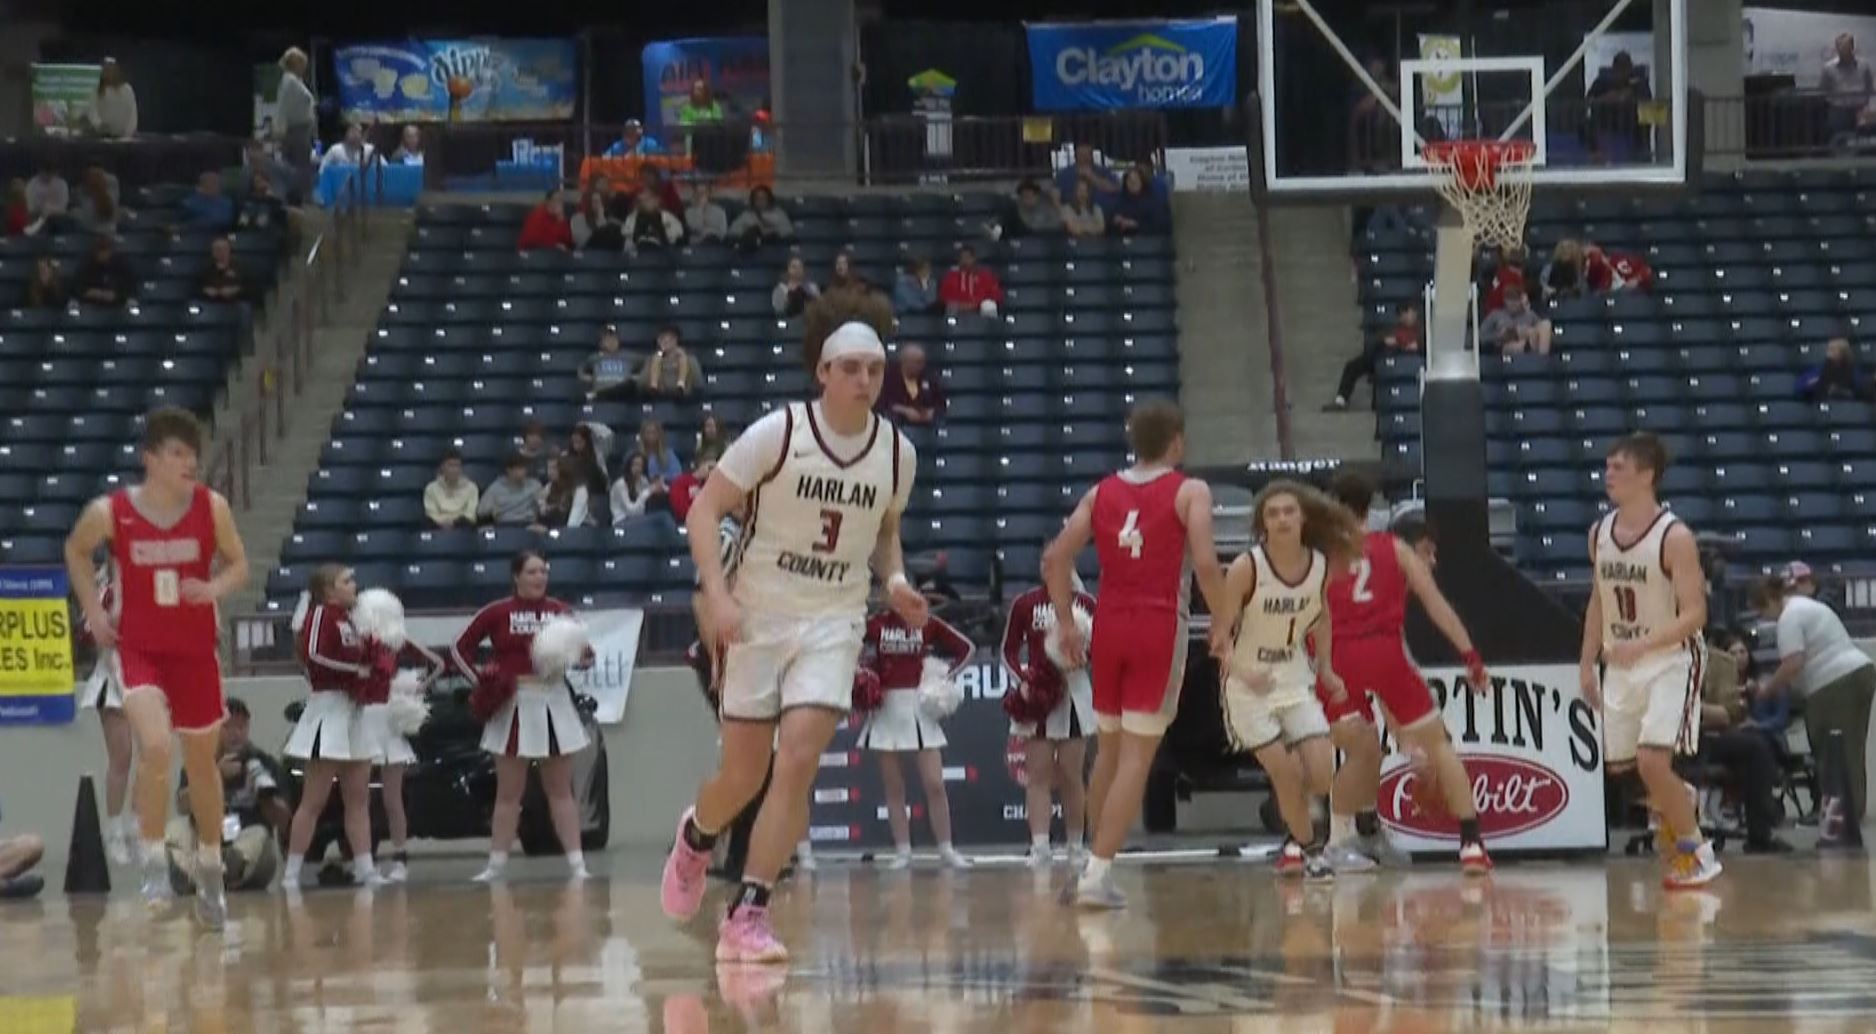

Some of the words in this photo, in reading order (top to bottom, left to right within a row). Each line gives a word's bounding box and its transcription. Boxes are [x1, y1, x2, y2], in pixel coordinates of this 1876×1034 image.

[1056, 47, 1204, 90] Clayton
[796, 475, 876, 510] HARLAN
[811, 508, 843, 554] 3
[1118, 509, 1144, 559] 4
[777, 551, 850, 583] COUNTY
[1349, 559, 1373, 603] 2
[1286, 616, 1296, 646] 1
[0, 646, 29, 672] ES
[34, 648, 70, 672] Inc.
